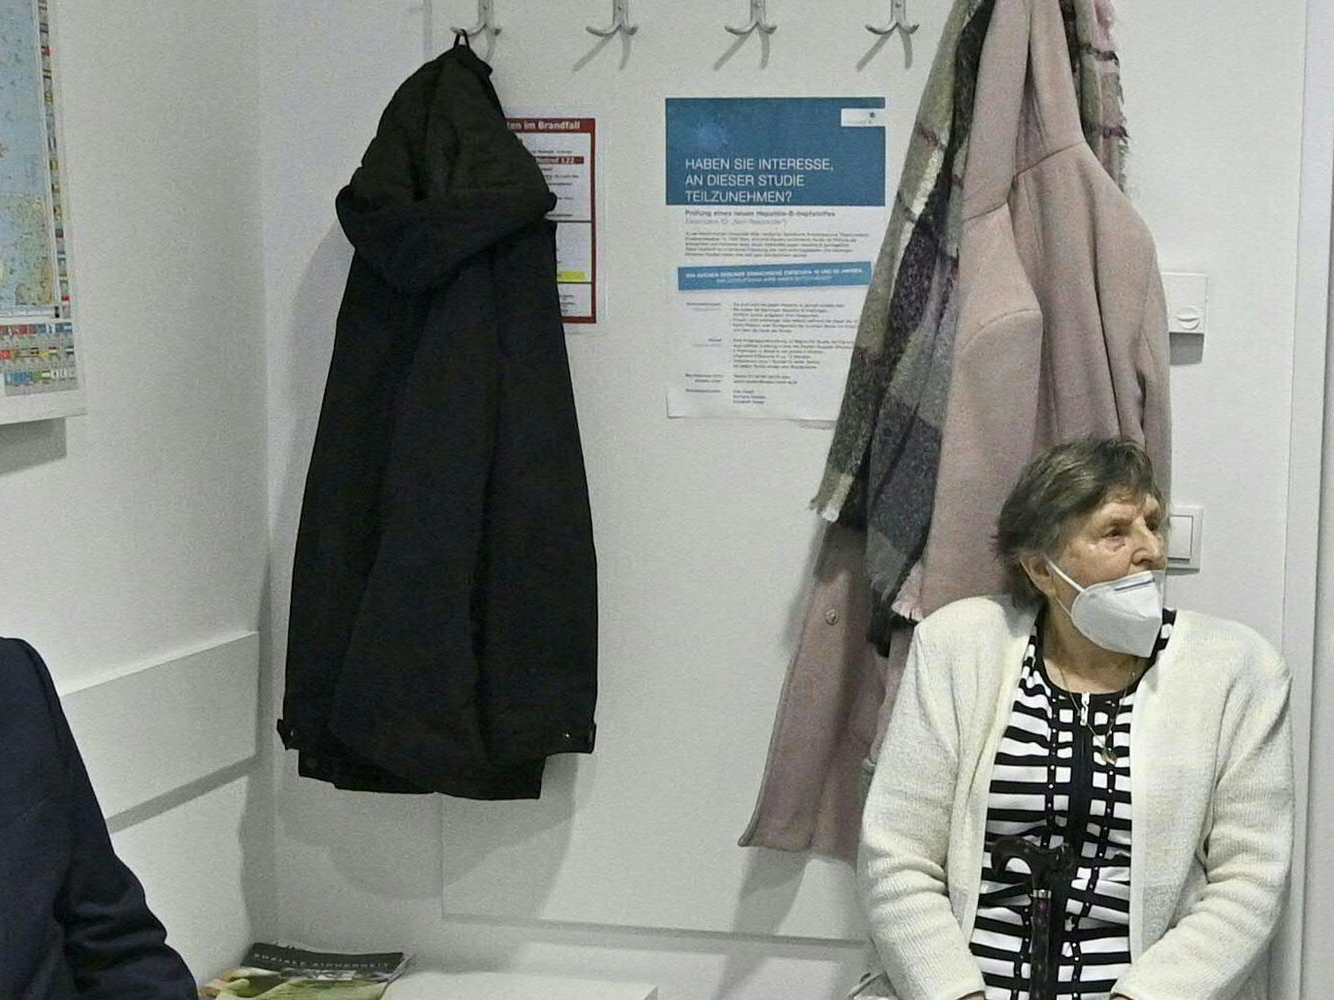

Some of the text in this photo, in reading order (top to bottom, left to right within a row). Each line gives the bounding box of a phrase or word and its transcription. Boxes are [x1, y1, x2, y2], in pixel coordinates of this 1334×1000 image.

[524, 120, 536, 130] im
[538, 120, 581, 131] Brandfall
[685, 158, 834, 172] HABEN SIE INTERESSE,
[685, 174, 805, 187] AN DIESER STUDIE
[685, 190, 792, 202] TEILZUNEHMEN?
